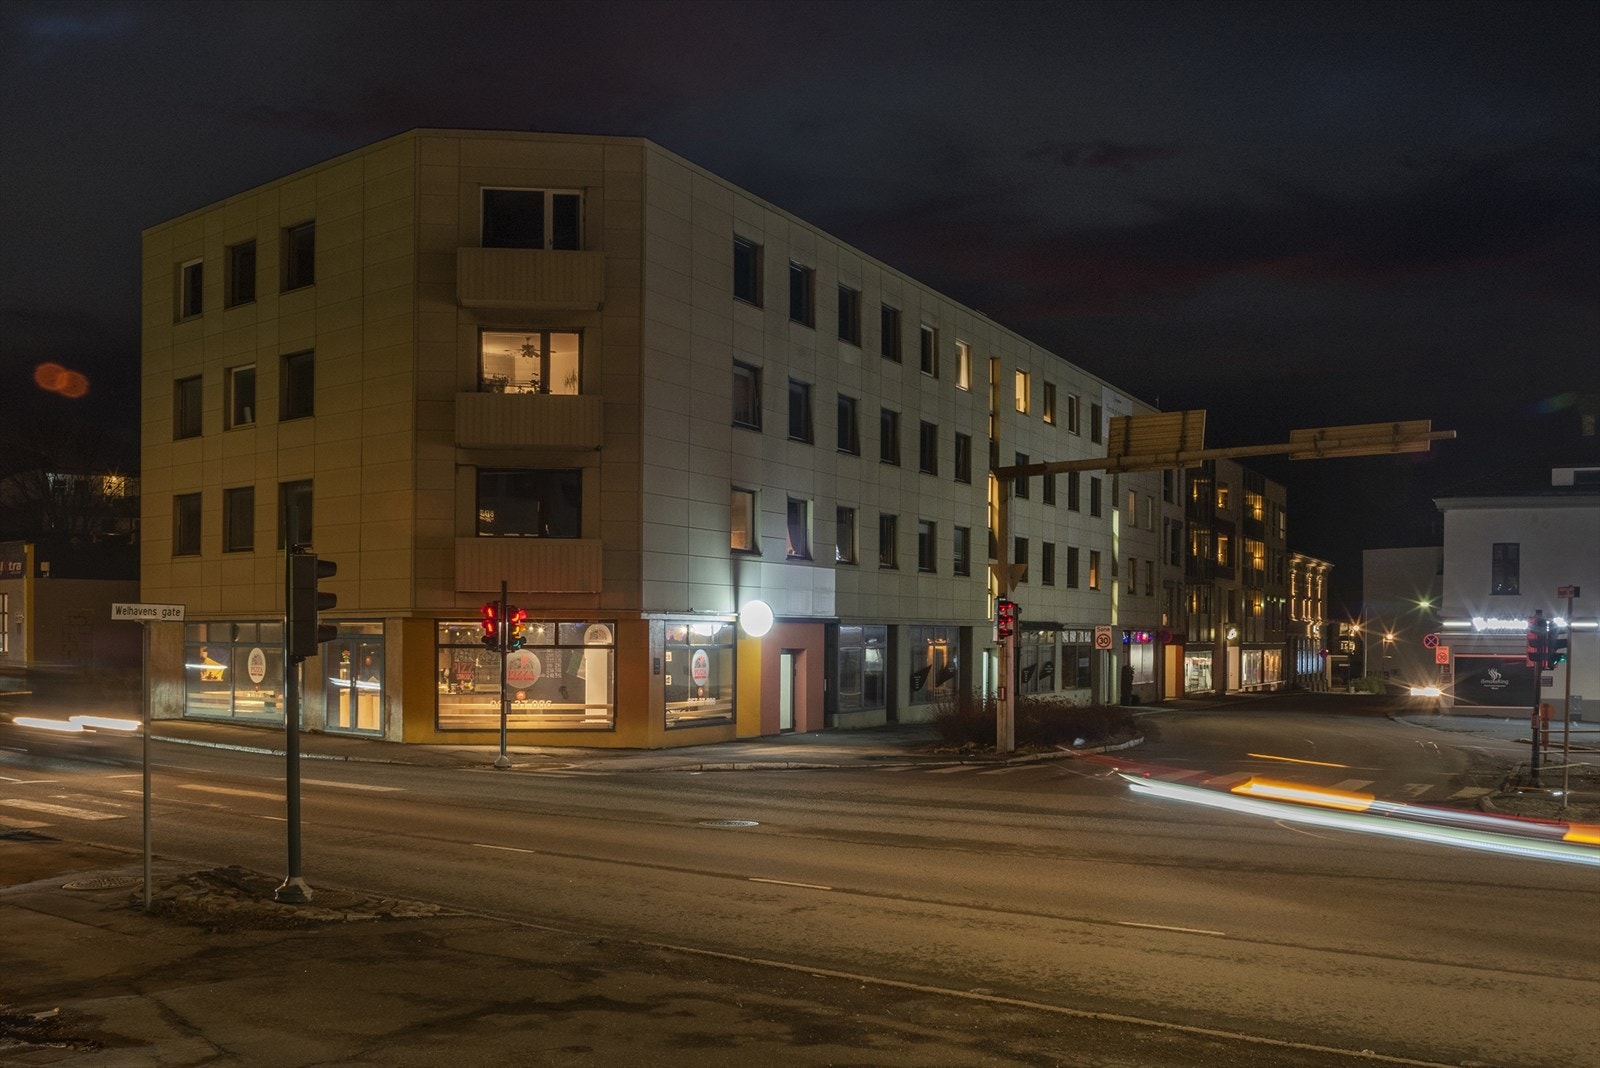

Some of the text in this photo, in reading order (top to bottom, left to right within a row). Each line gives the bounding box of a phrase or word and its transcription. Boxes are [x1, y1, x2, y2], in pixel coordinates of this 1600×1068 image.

[115, 605, 181, 618] Welhavens gate
[514, 700, 529, 709] 37
